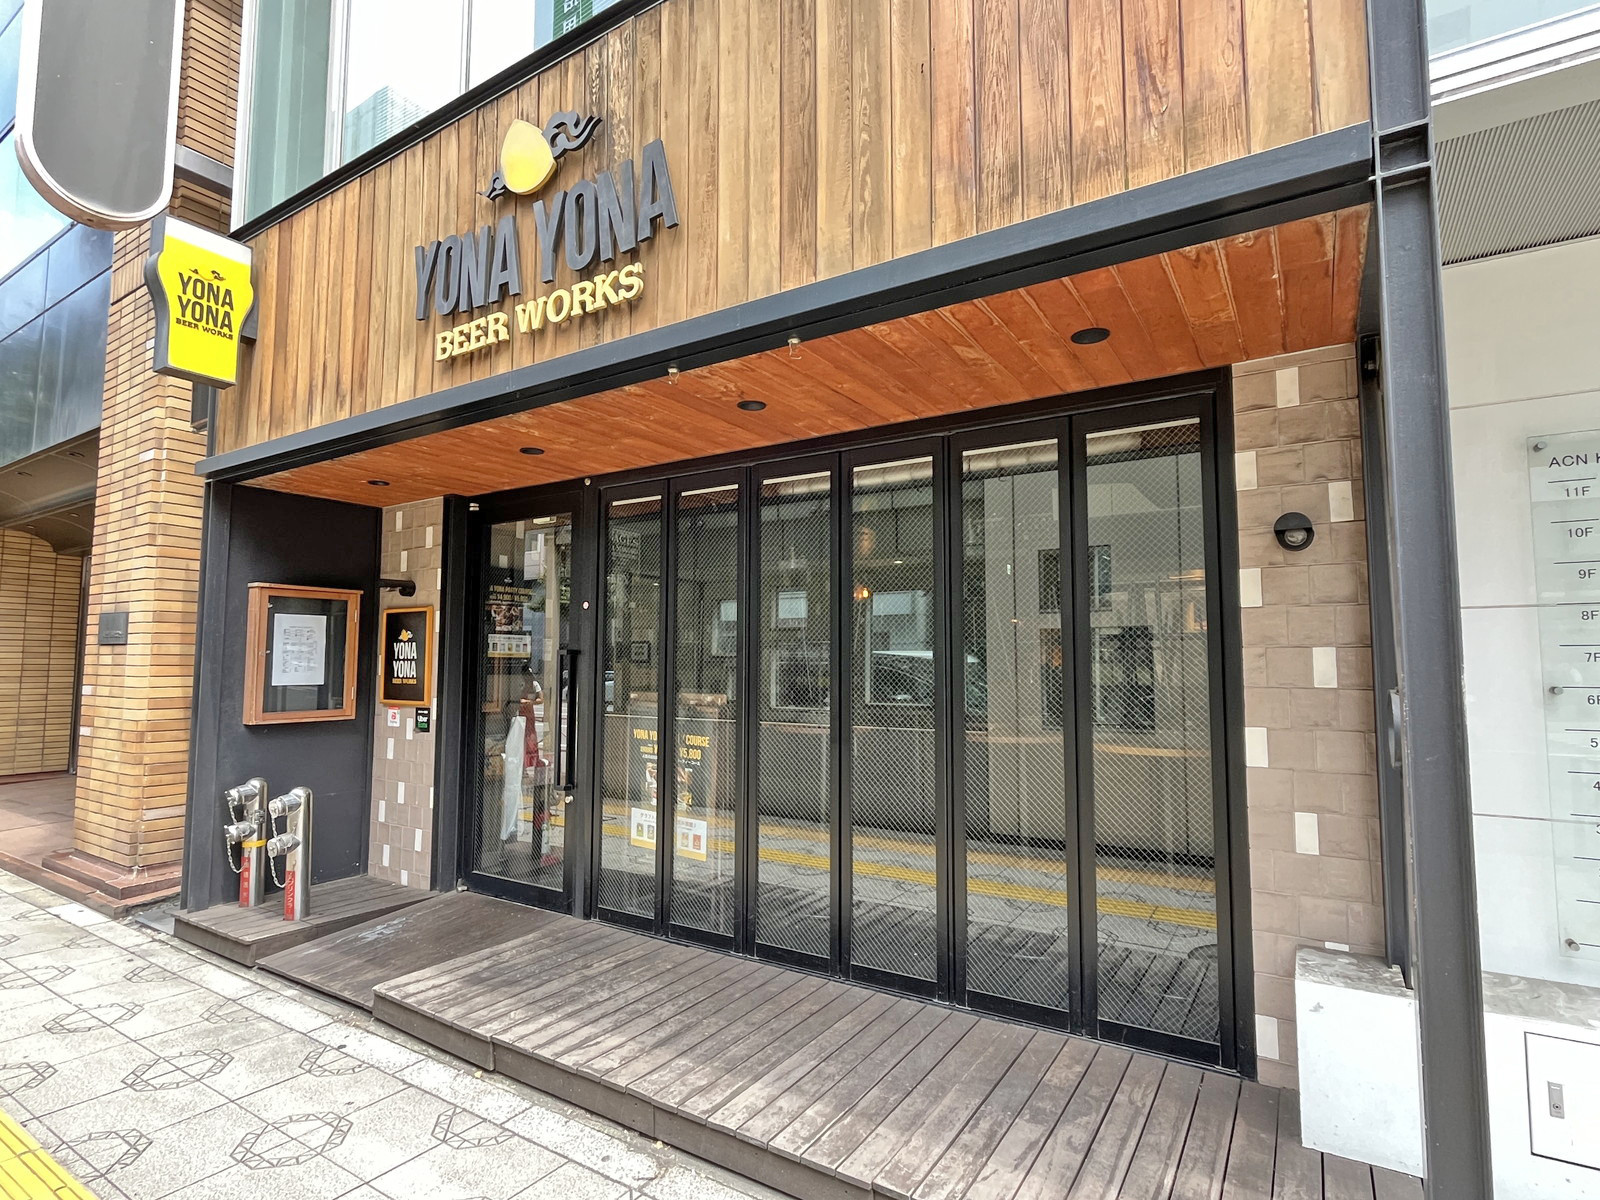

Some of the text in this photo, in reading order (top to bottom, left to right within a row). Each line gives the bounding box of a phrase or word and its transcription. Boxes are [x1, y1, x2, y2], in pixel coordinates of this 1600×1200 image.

[415, 138, 680, 320] YONA YONA
[178, 272, 234, 311] YONA
[177, 295, 233, 333] YONA
[435, 262, 646, 361] BEER WORKS
[176, 318, 233, 340] BEER WORKS
[1549, 453, 1588, 468] ACN
[1565, 486, 1591, 497] 11F
[1568, 527, 1594, 538] 10F
[1578, 568, 1597, 579] 9F
[1581, 610, 1599, 621] 8F
[393, 642, 417, 659] YONA
[1584, 652, 1600, 663] 7F
[392, 660, 416, 678] YONA
[633, 729, 649, 740] YONA
[686, 735, 710, 747] COURSE
